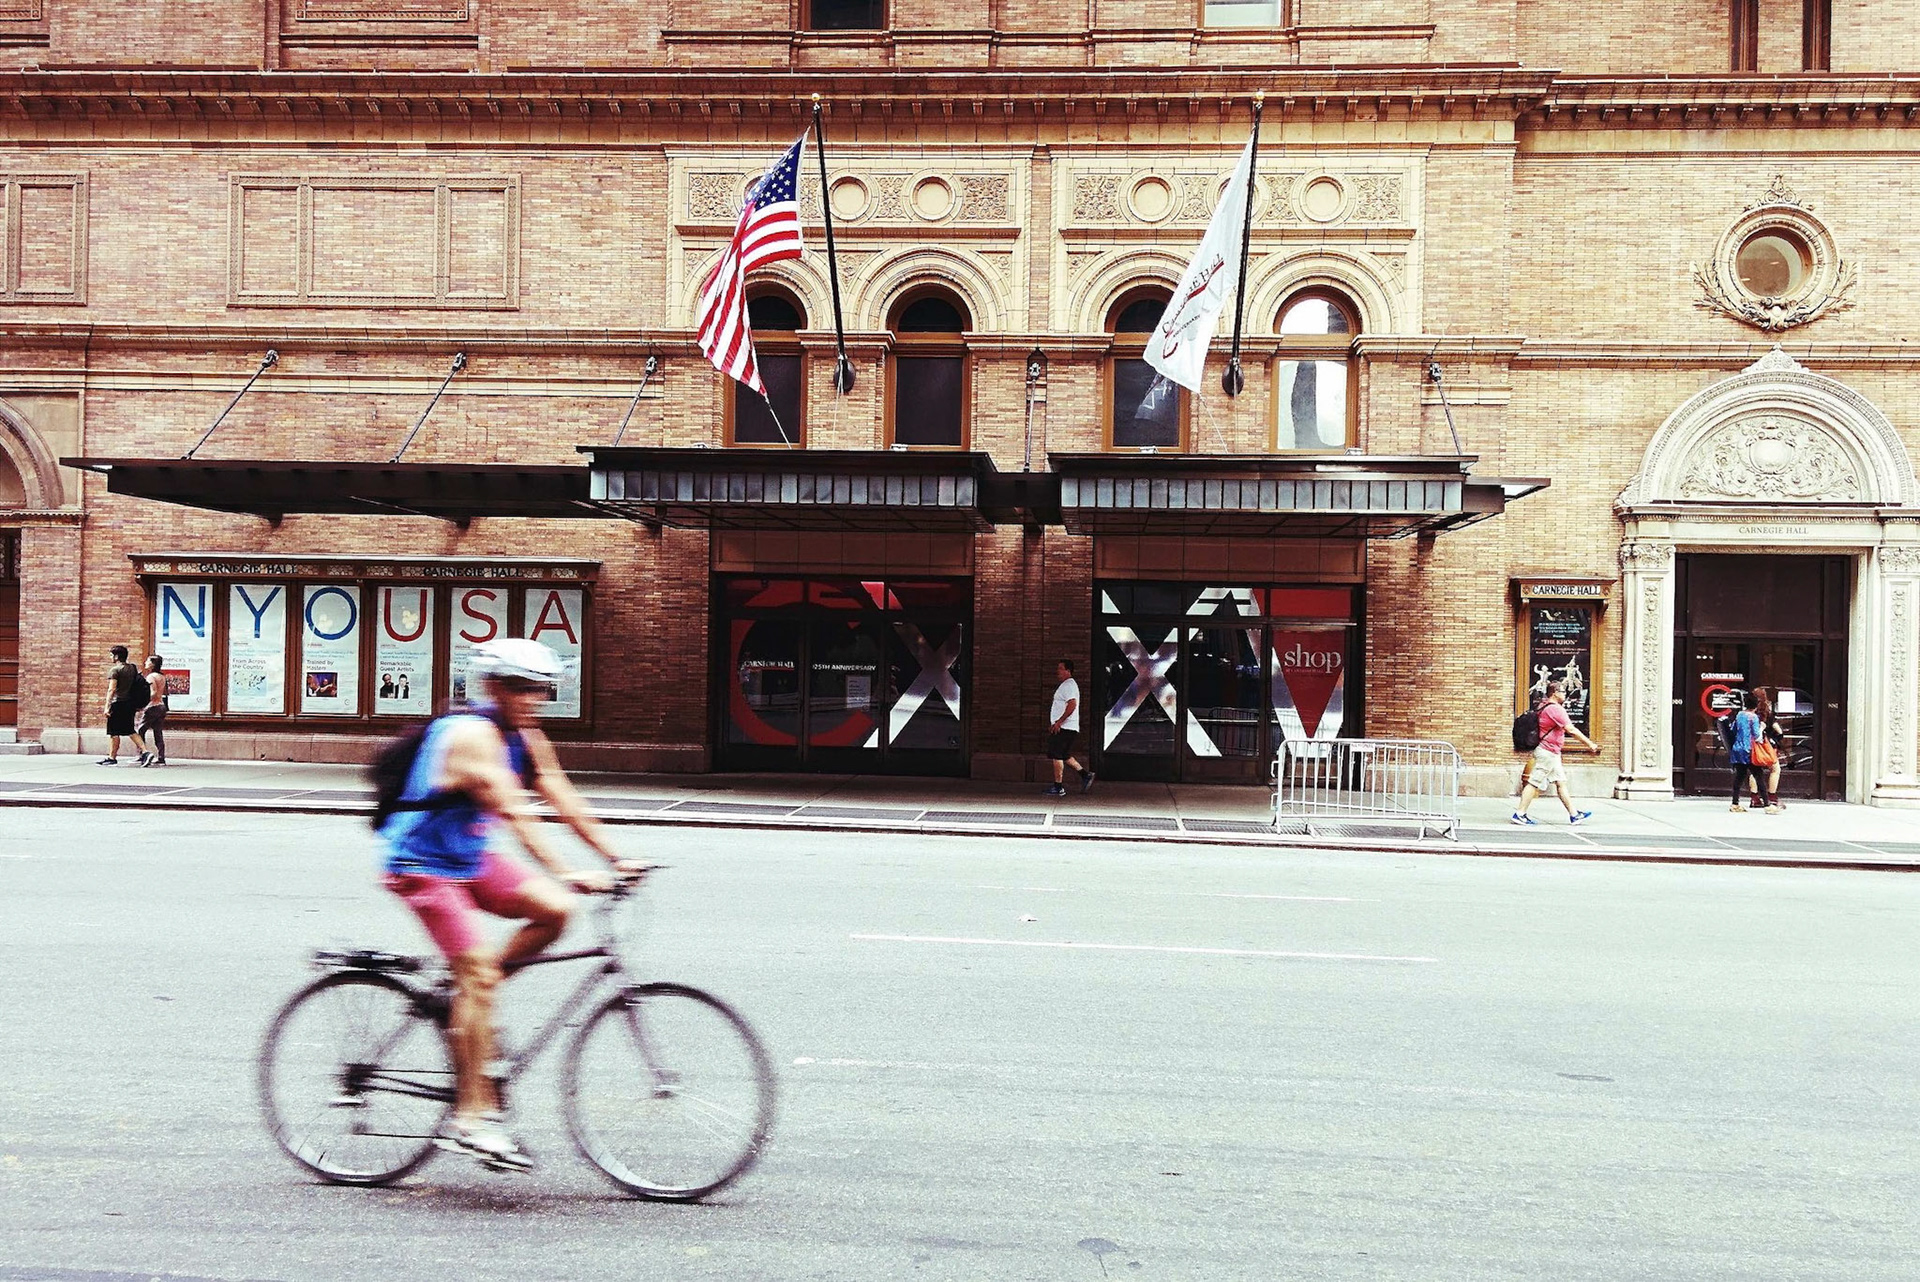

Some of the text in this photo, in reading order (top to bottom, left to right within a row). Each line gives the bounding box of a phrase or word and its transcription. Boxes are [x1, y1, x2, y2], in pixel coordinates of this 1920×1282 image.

[1738, 526, 1809, 535] CARNEGIE HALL
[200, 563, 297, 574] CARNEGIE HALL
[424, 567, 523, 578] CARNEGIE HALL
[1532, 585, 1601, 596] CARNEGIE HALL
[1284, 643, 1342, 674] shop
[831, 664, 877, 672] ANNIVERSARY
